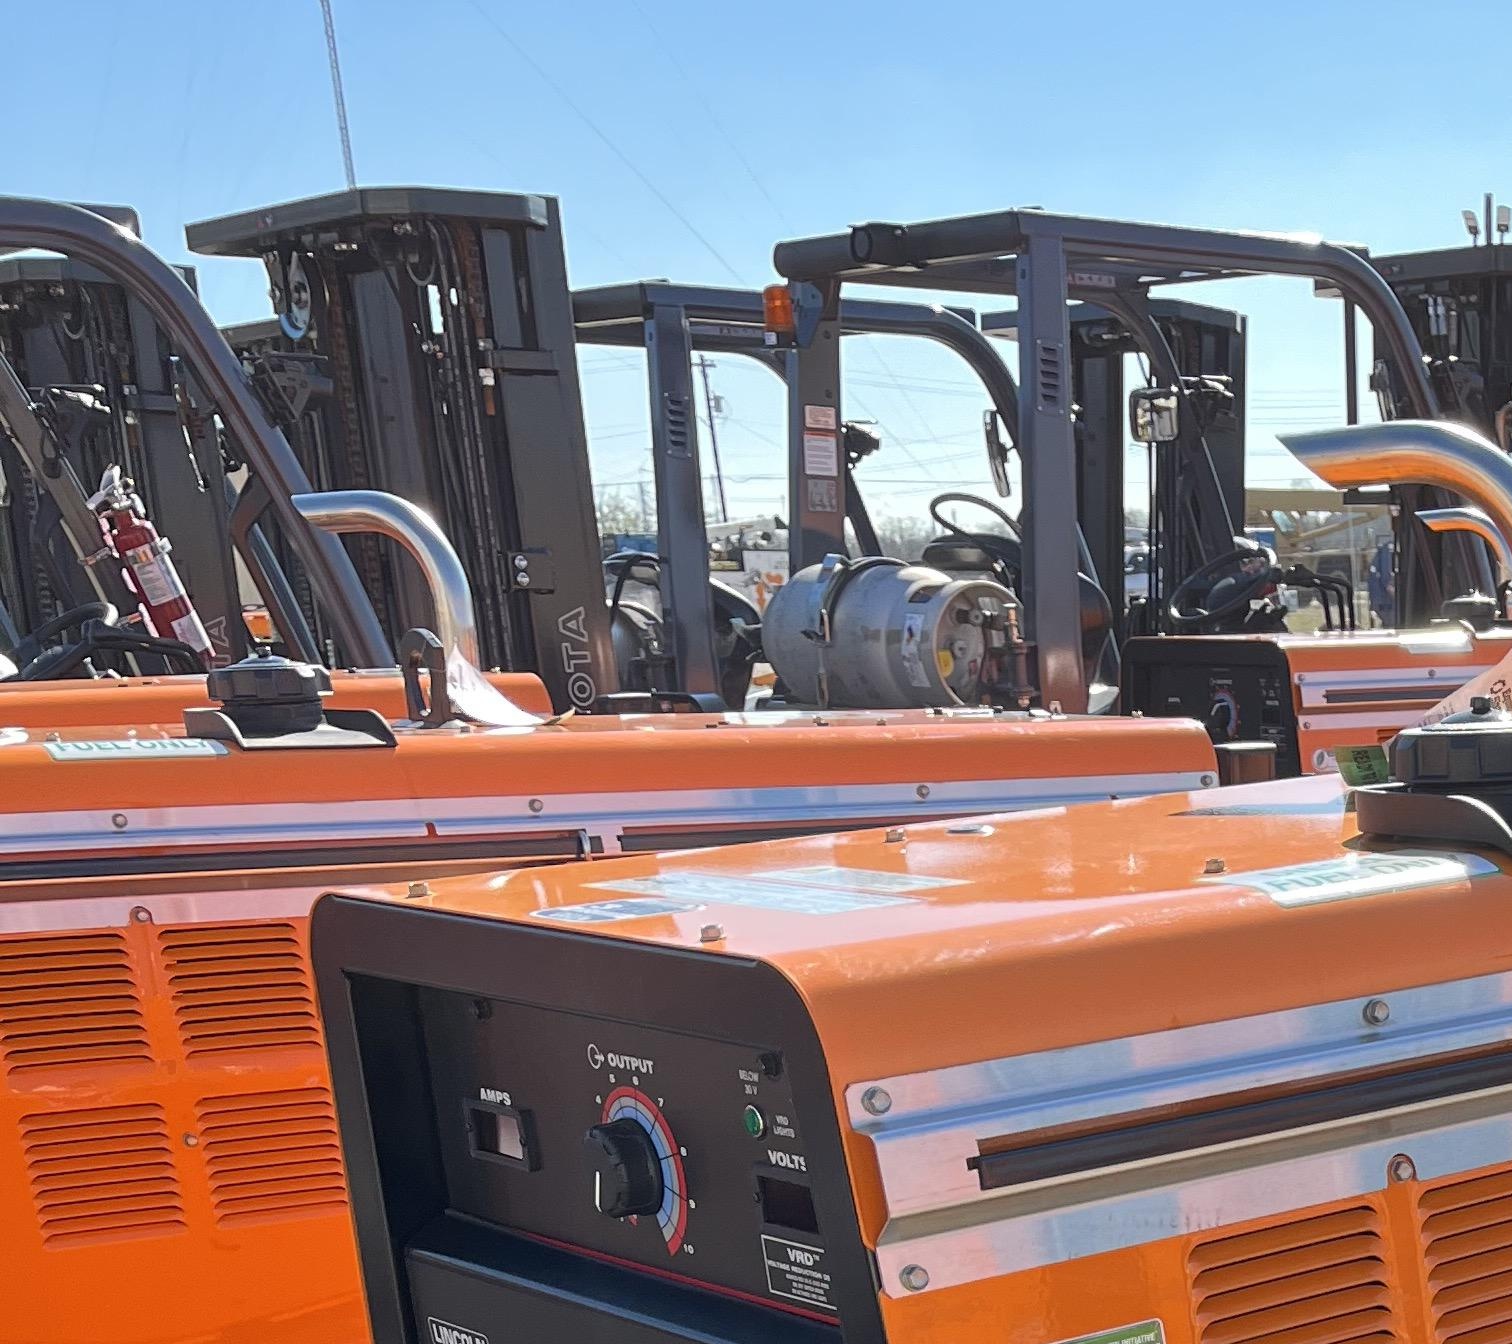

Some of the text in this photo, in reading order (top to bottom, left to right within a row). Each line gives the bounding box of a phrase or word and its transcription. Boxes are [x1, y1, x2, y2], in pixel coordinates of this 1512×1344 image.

[558, 606, 597, 713] OTA
[607, 1053, 654, 1075] OUTPUT
[479, 1086, 513, 1107] AMPS
